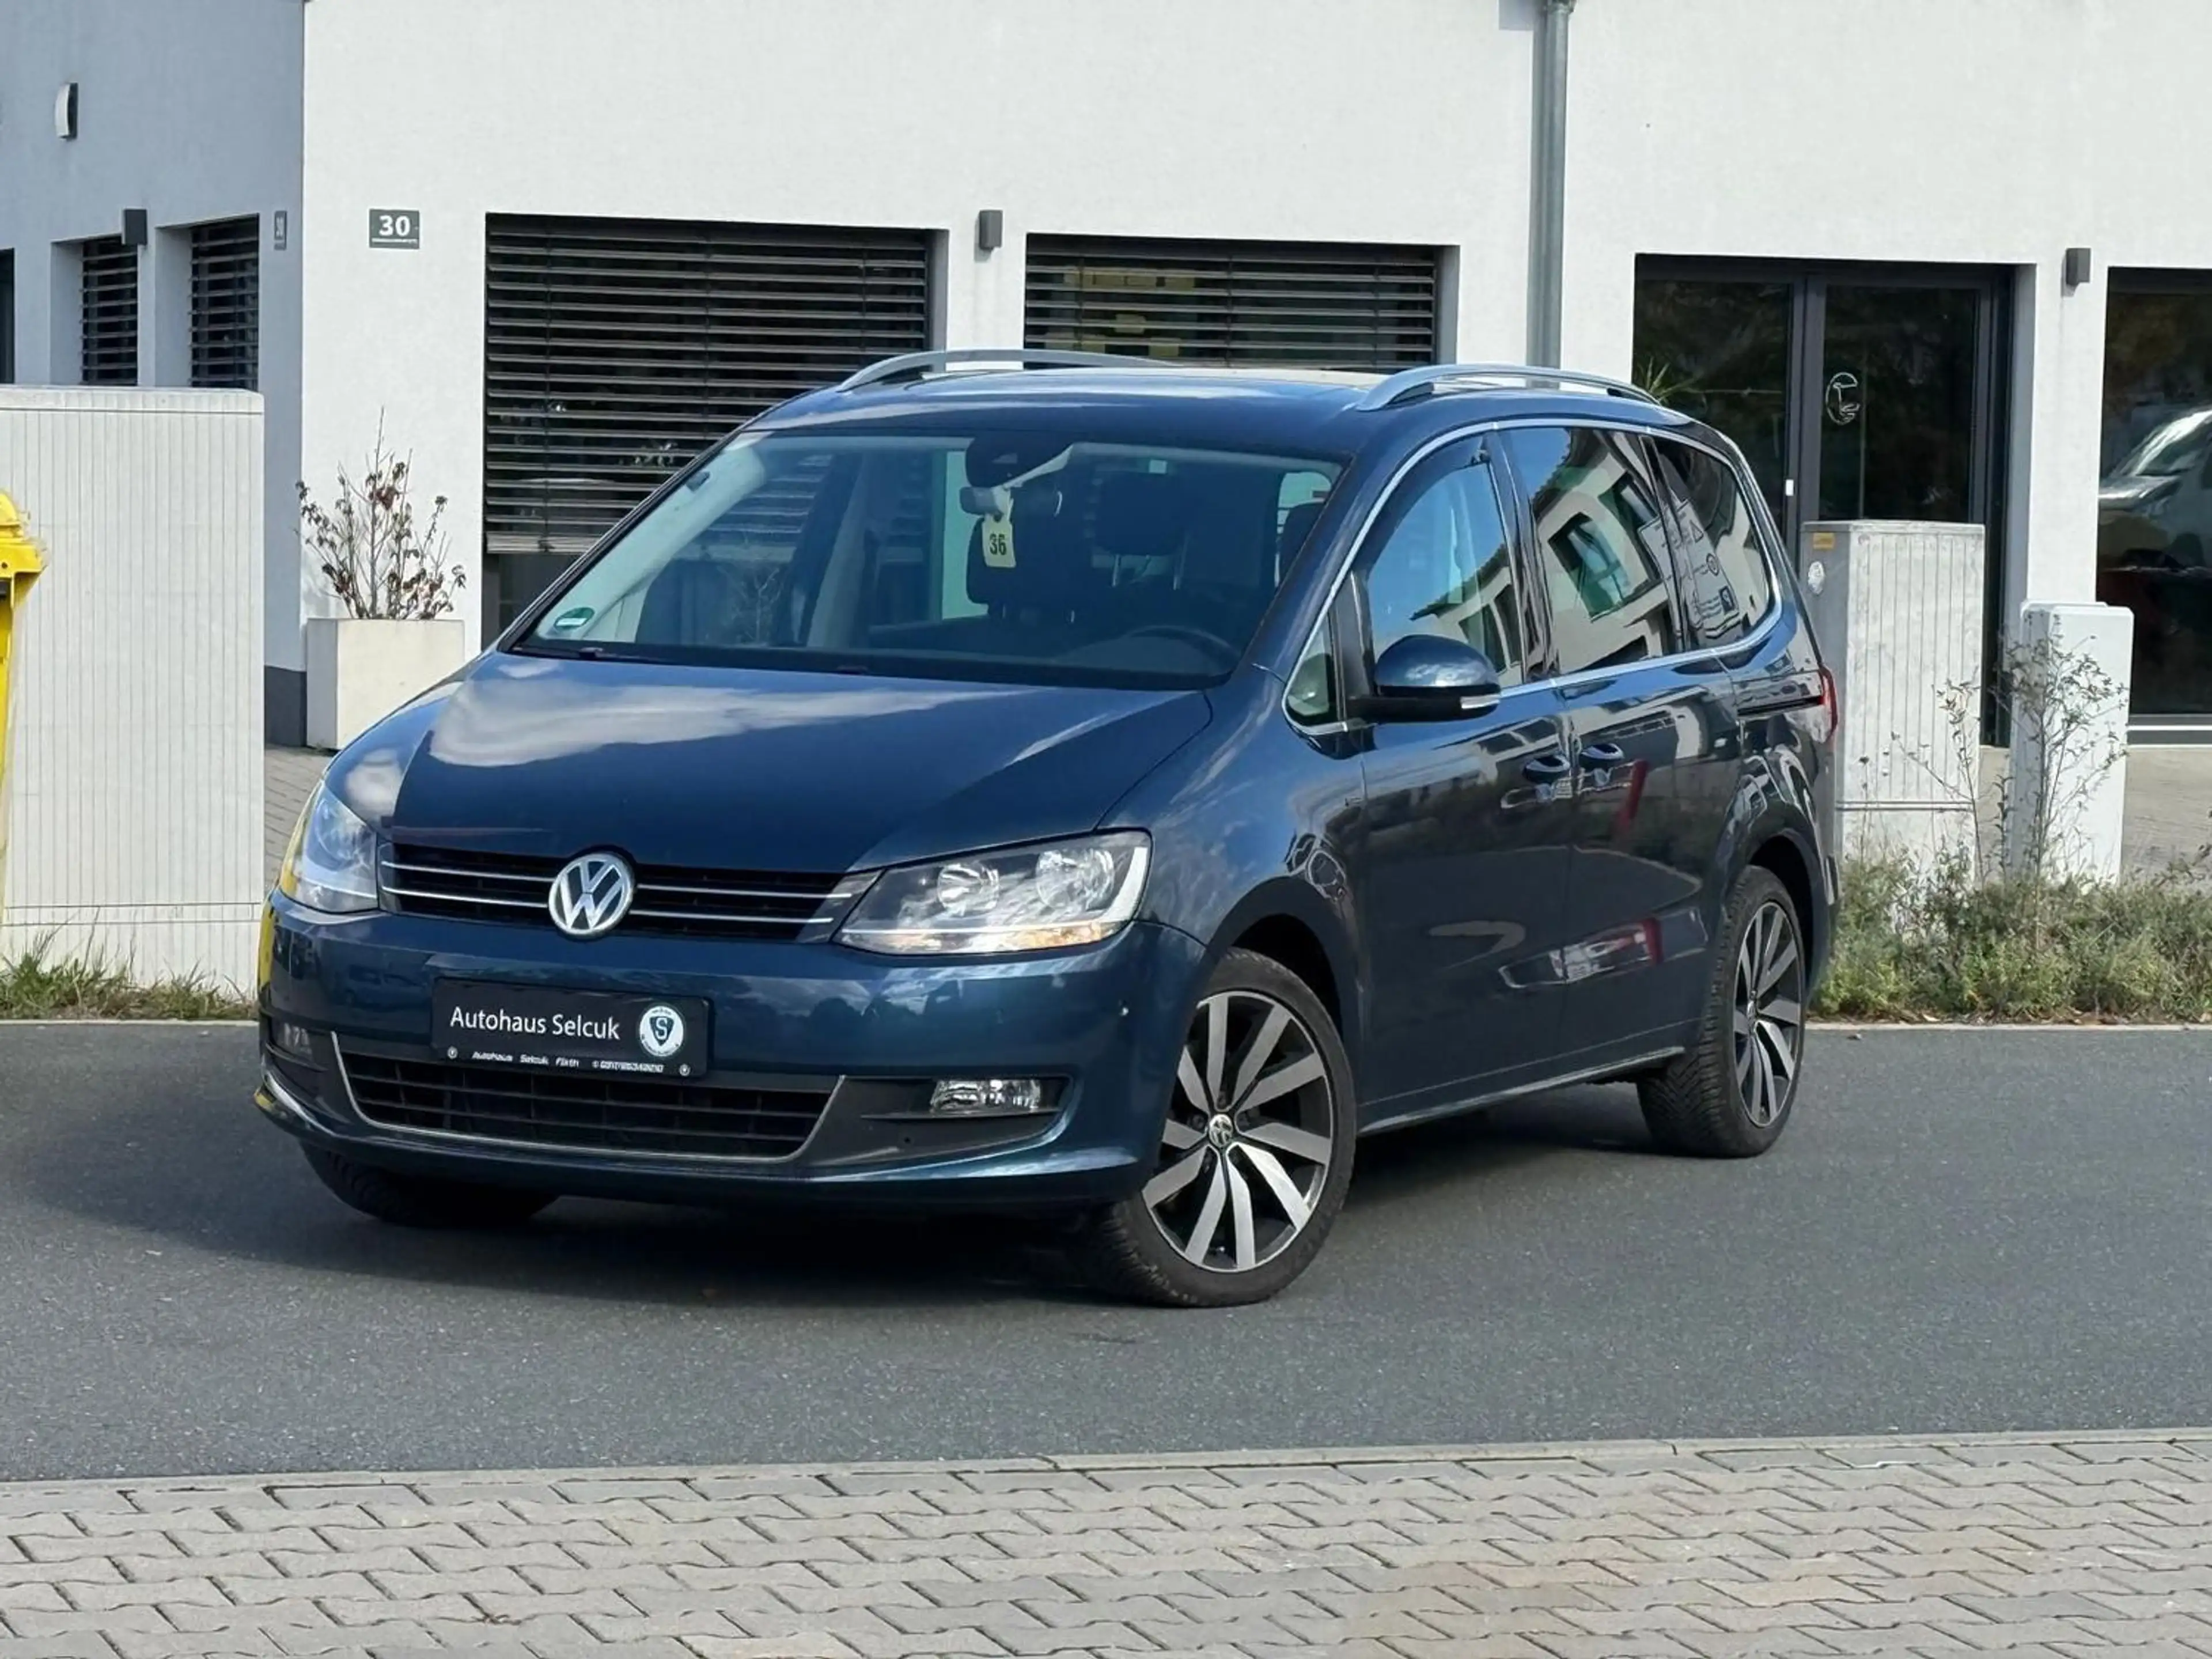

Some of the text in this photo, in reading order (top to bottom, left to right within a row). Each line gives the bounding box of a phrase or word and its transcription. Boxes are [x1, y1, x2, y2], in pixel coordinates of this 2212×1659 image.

[379, 215, 410, 237] 30
[989, 534, 1006, 556] 36
[554, 857, 629, 931] VW
[450, 1006, 620, 1040] Autohaus Selcuk
